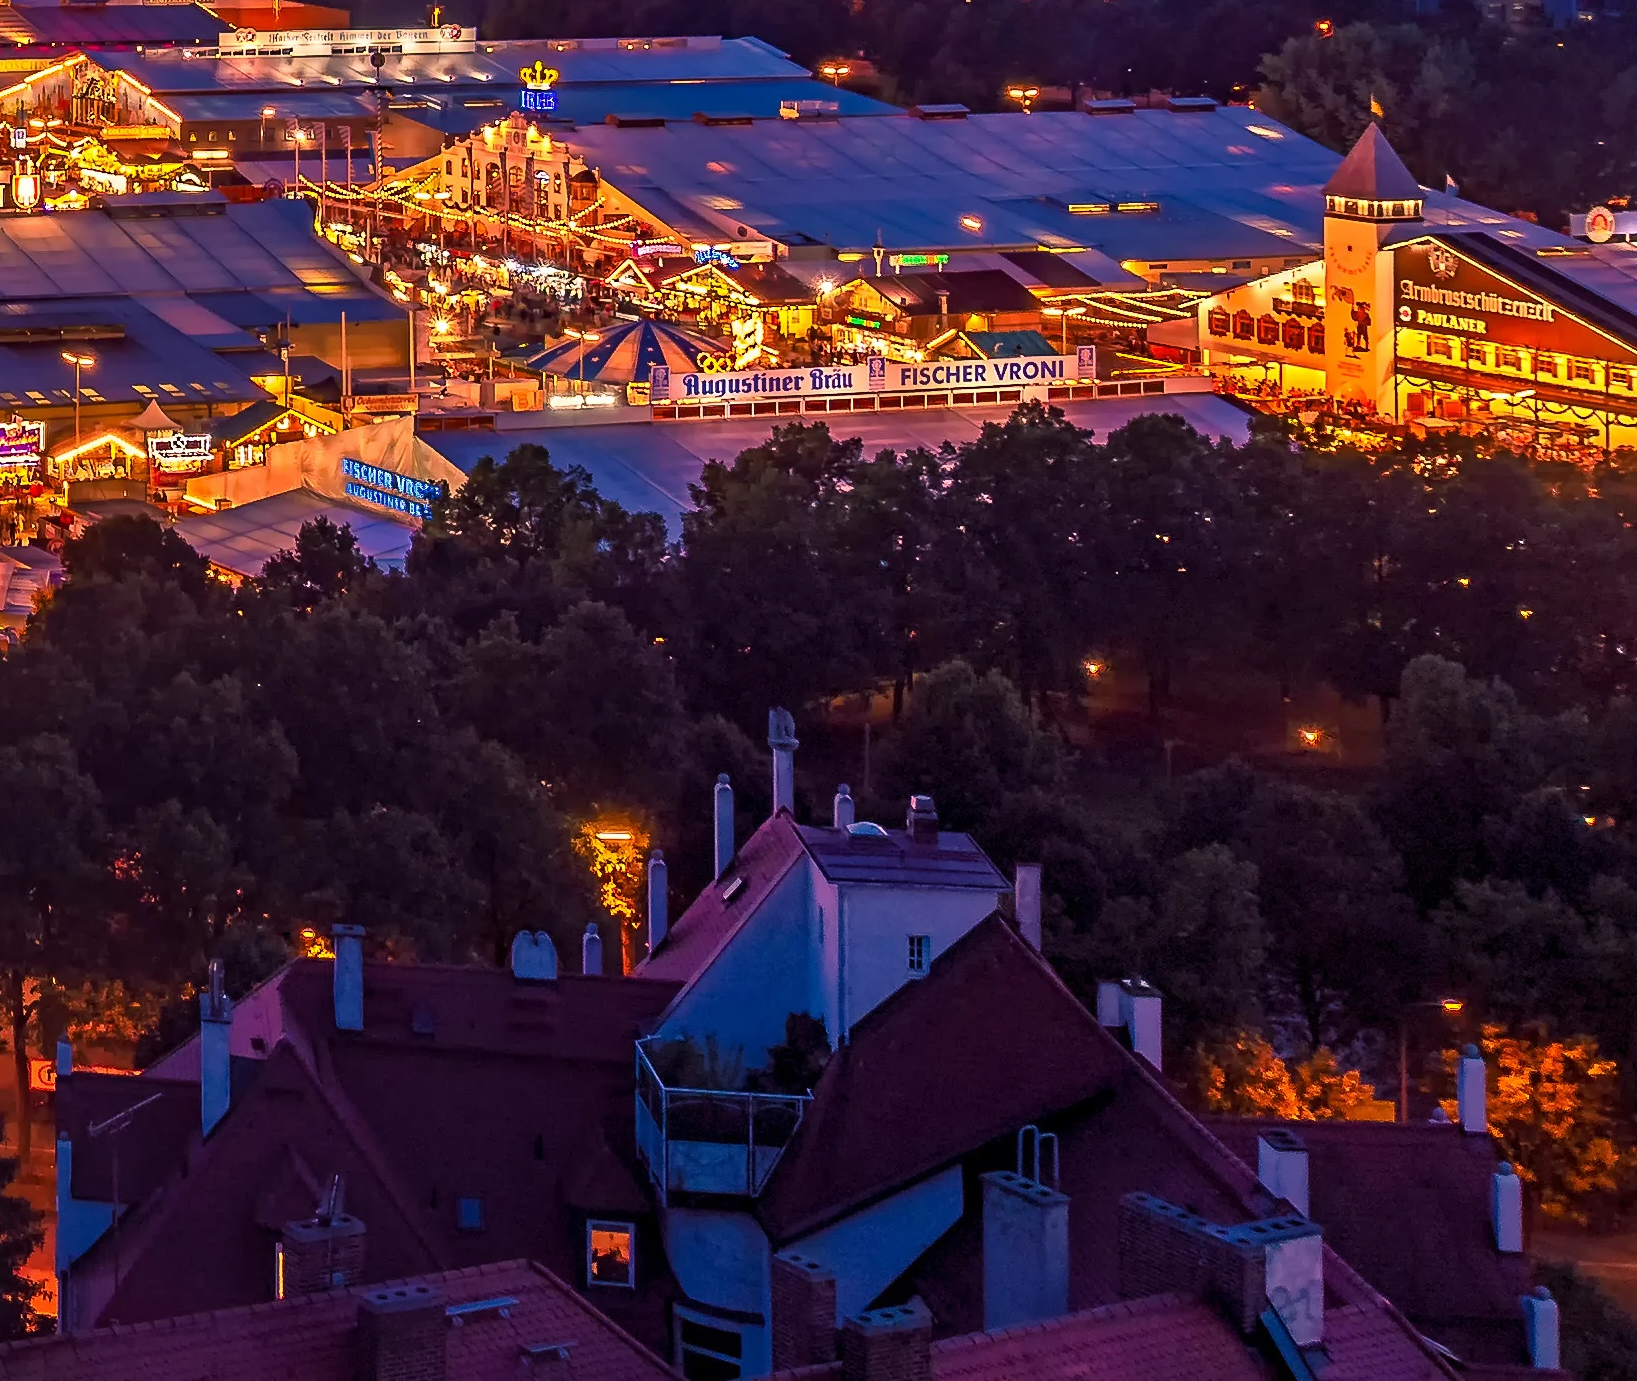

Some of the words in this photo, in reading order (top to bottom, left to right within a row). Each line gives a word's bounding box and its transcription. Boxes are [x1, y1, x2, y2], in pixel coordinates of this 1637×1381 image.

[377, 30, 391, 40] der
[1416, 309, 1488, 335] PAULANER
[682, 373, 805, 397] Augustiner
[809, 367, 854, 391] Bräu
[899, 364, 987, 387] FISCHER
[993, 359, 1065, 382] VRONI
[342, 458, 393, 491] FISCHER
